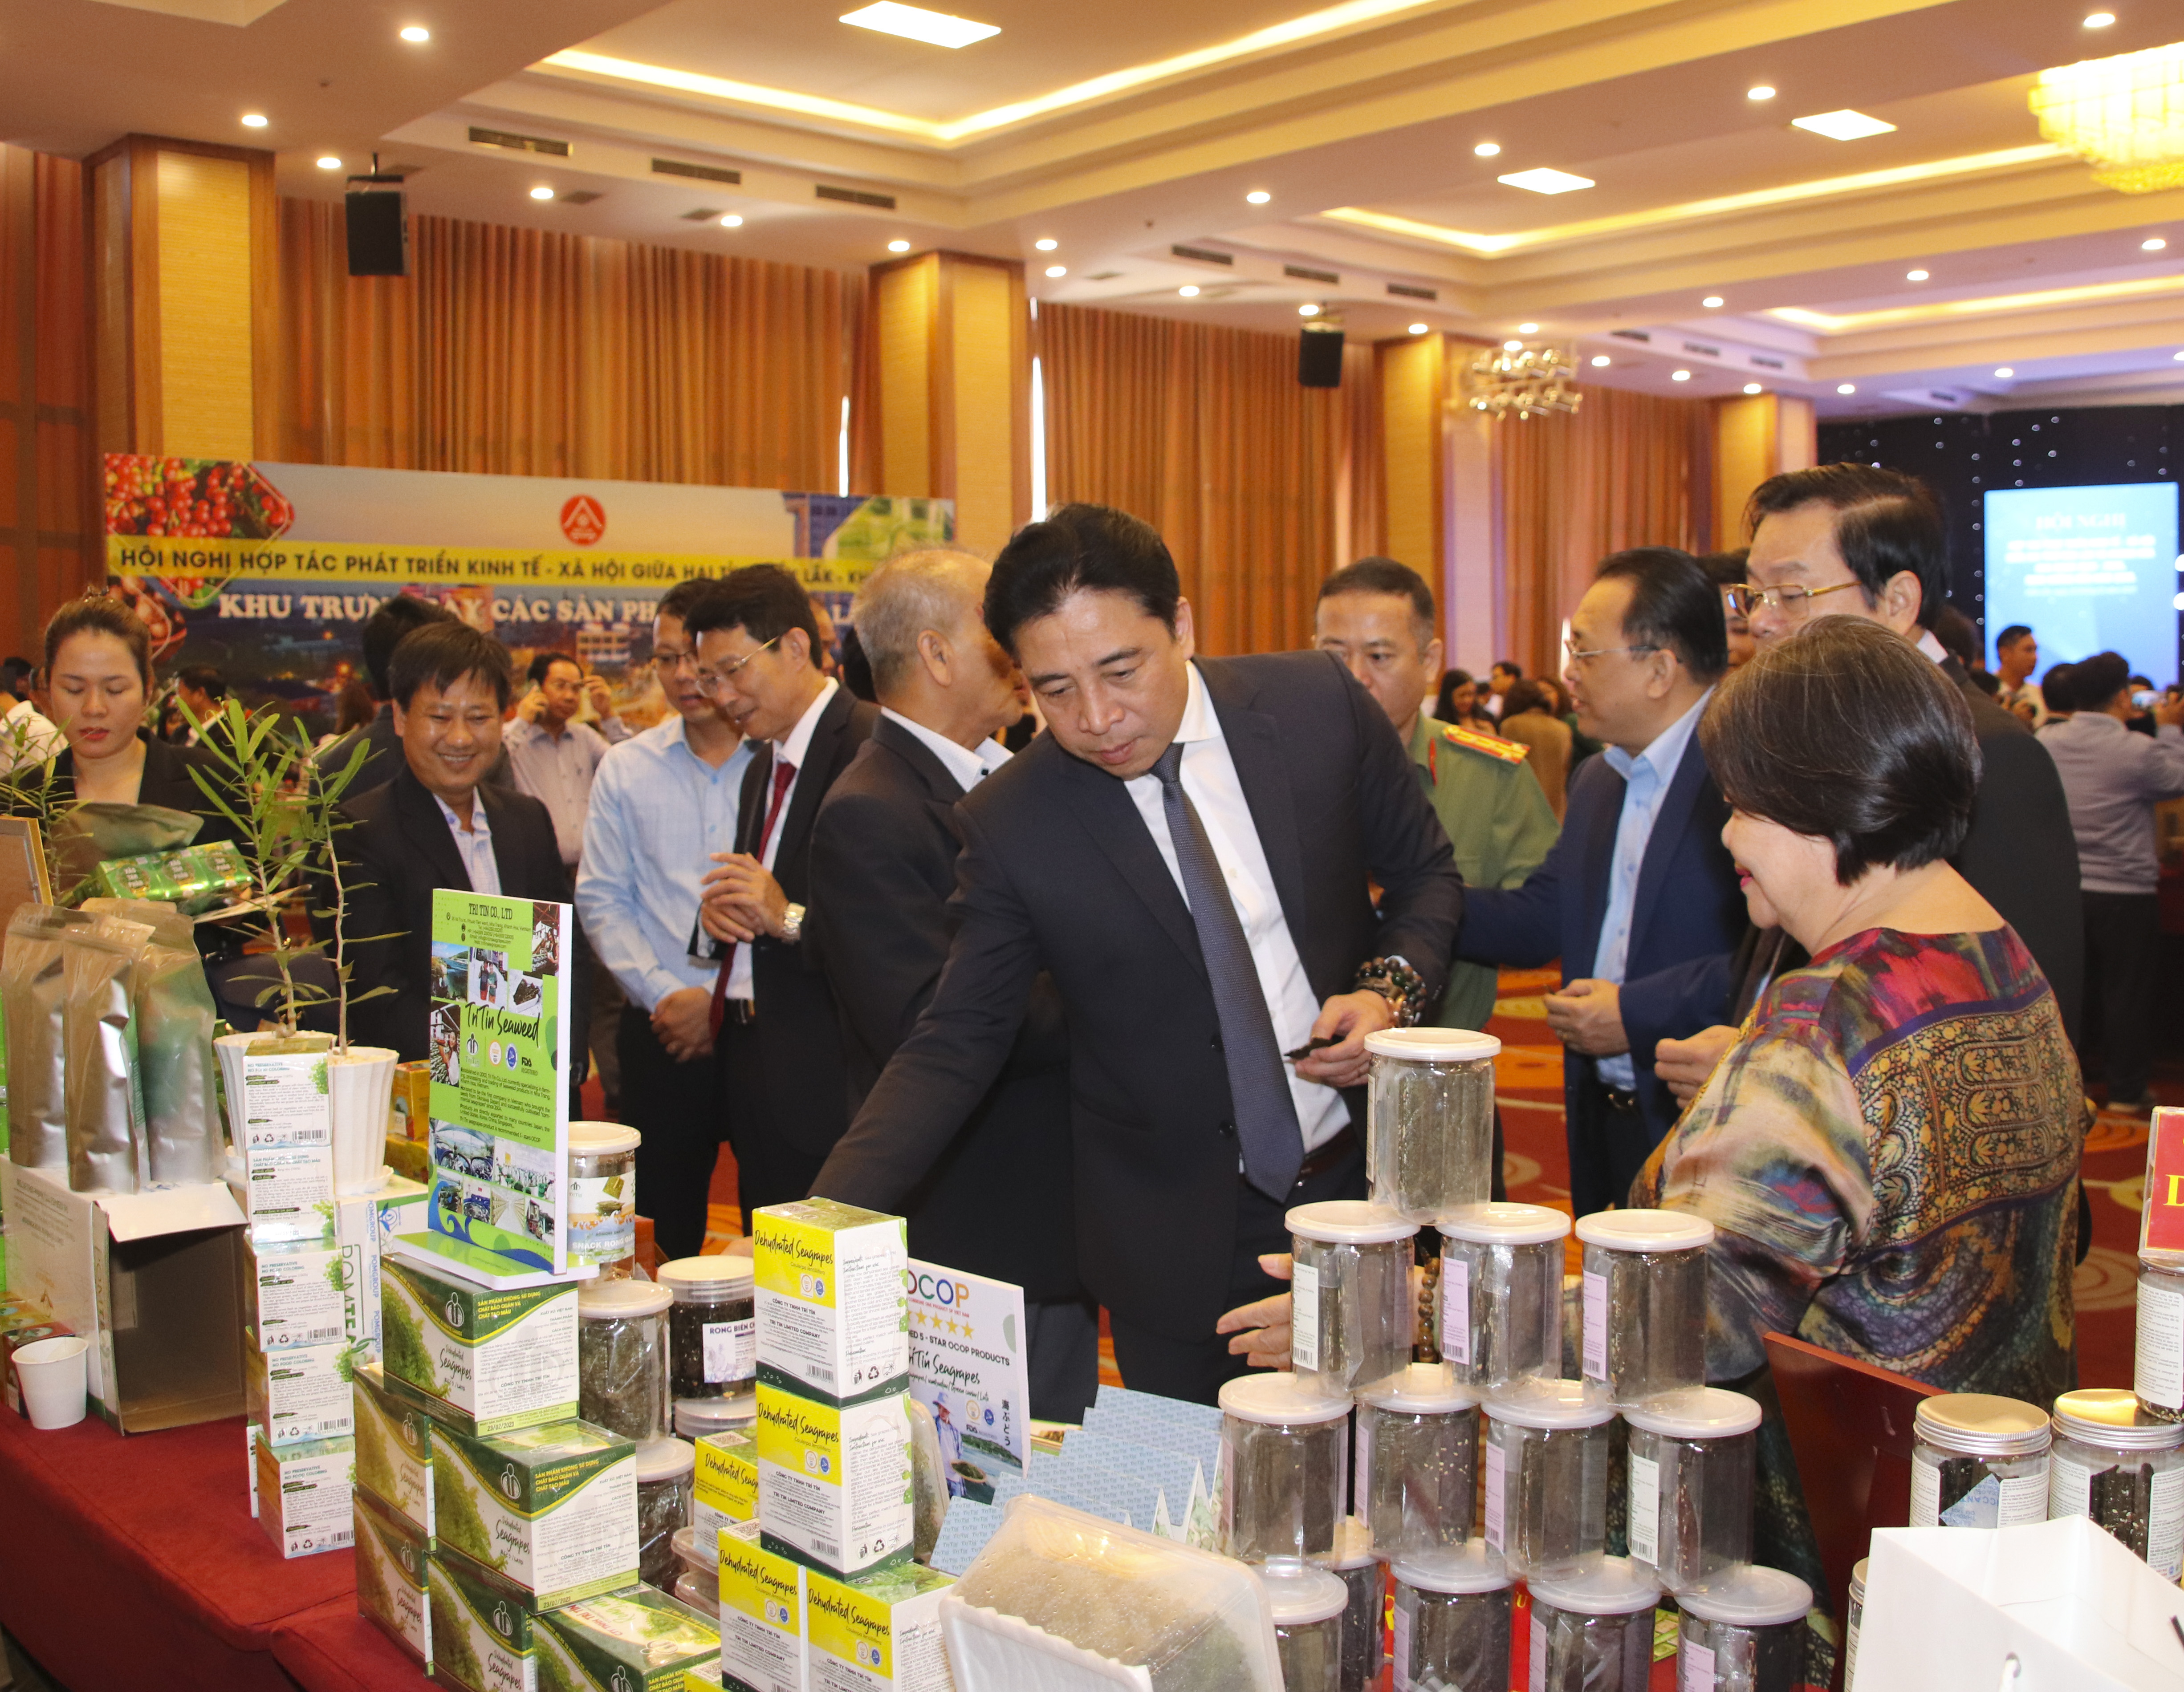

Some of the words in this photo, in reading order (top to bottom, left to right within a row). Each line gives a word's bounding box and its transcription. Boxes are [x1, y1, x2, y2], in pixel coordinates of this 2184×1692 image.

[121, 544, 163, 572] HỘI
[173, 551, 232, 574] NGHỊ
[241, 550, 287, 574] HỢP
[296, 550, 337, 572] TÁC
[346, 551, 399, 573] PHÁT
[407, 549, 459, 575] TRIỂN
[468, 557, 514, 576] KINH
[521, 554, 542, 577] TẾ
[559, 559, 585, 578] XÃ
[592, 559, 626, 581] HỘI
[631, 560, 677, 579] GIỮA
[219, 593, 293, 620] KHU
[301, 593, 386, 621] TRƯ
[491, 594, 551, 622] CÁC
[556, 592, 614, 623] SẢN
[621, 599, 659, 623] PH
[469, 903, 478, 915] TRI
[480, 905, 489, 917] TIN
[501, 908, 513, 920] LTD
[497, 1006, 540, 1048] Seaweed
[521, 1057, 532, 1067] FDA
[604, 1237, 625, 1247] RONG
[755, 1229, 794, 1260] Dehydrated
[796, 1239, 833, 1267] Seagrapes
[371, 1254, 380, 1298] POMGROUP
[710, 1327, 732, 1335] RONG
[440, 1347, 472, 1381] Seagrapes
[929, 1336, 947, 1347] STAR
[948, 1341, 969, 1354] OCOP
[971, 1346, 1010, 1366] PRODUCTS
[934, 1354, 980, 1386] Seagrapes
[759, 1402, 799, 1435] Dehydrated
[800, 1416, 839, 1445] Seagrapes
[705, 1453, 740, 1485] Dehydrated
[496, 1518, 530, 1554] Seagrapes
[720, 1550, 759, 1584] Dehydrated
[761, 1567, 797, 1596] Seagrapes
[809, 1588, 849, 1625] Dehydrated
[851, 1606, 890, 1637] Seagrapes
[488, 1652, 521, 1690] Seagrapes
